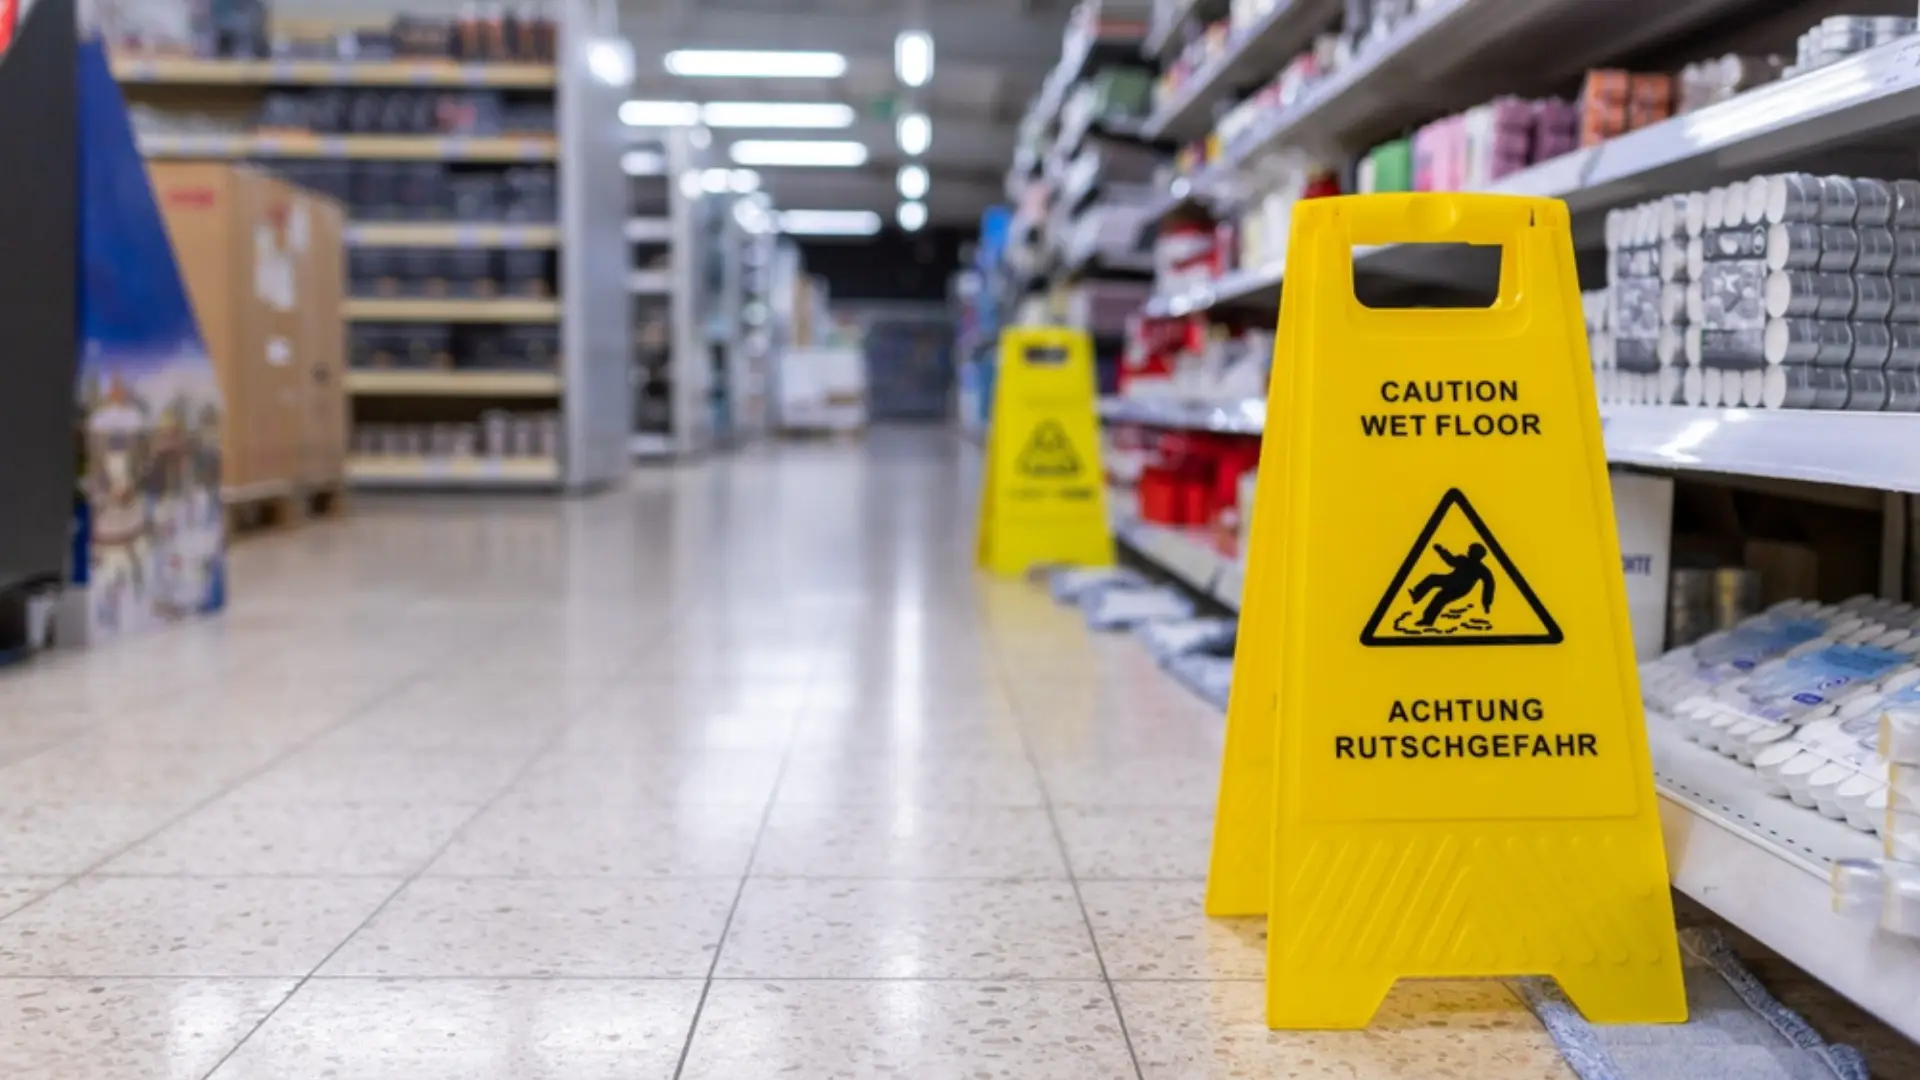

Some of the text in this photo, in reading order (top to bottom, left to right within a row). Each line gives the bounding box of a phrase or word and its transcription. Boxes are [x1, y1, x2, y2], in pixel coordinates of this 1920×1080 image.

[1380, 380, 1518, 403] CAUTION
[1360, 413, 1541, 437] WET FLOOR
[1388, 698, 1545, 723] ACHTUNG
[1335, 733, 1599, 759] RUTSCHGEFAHR
